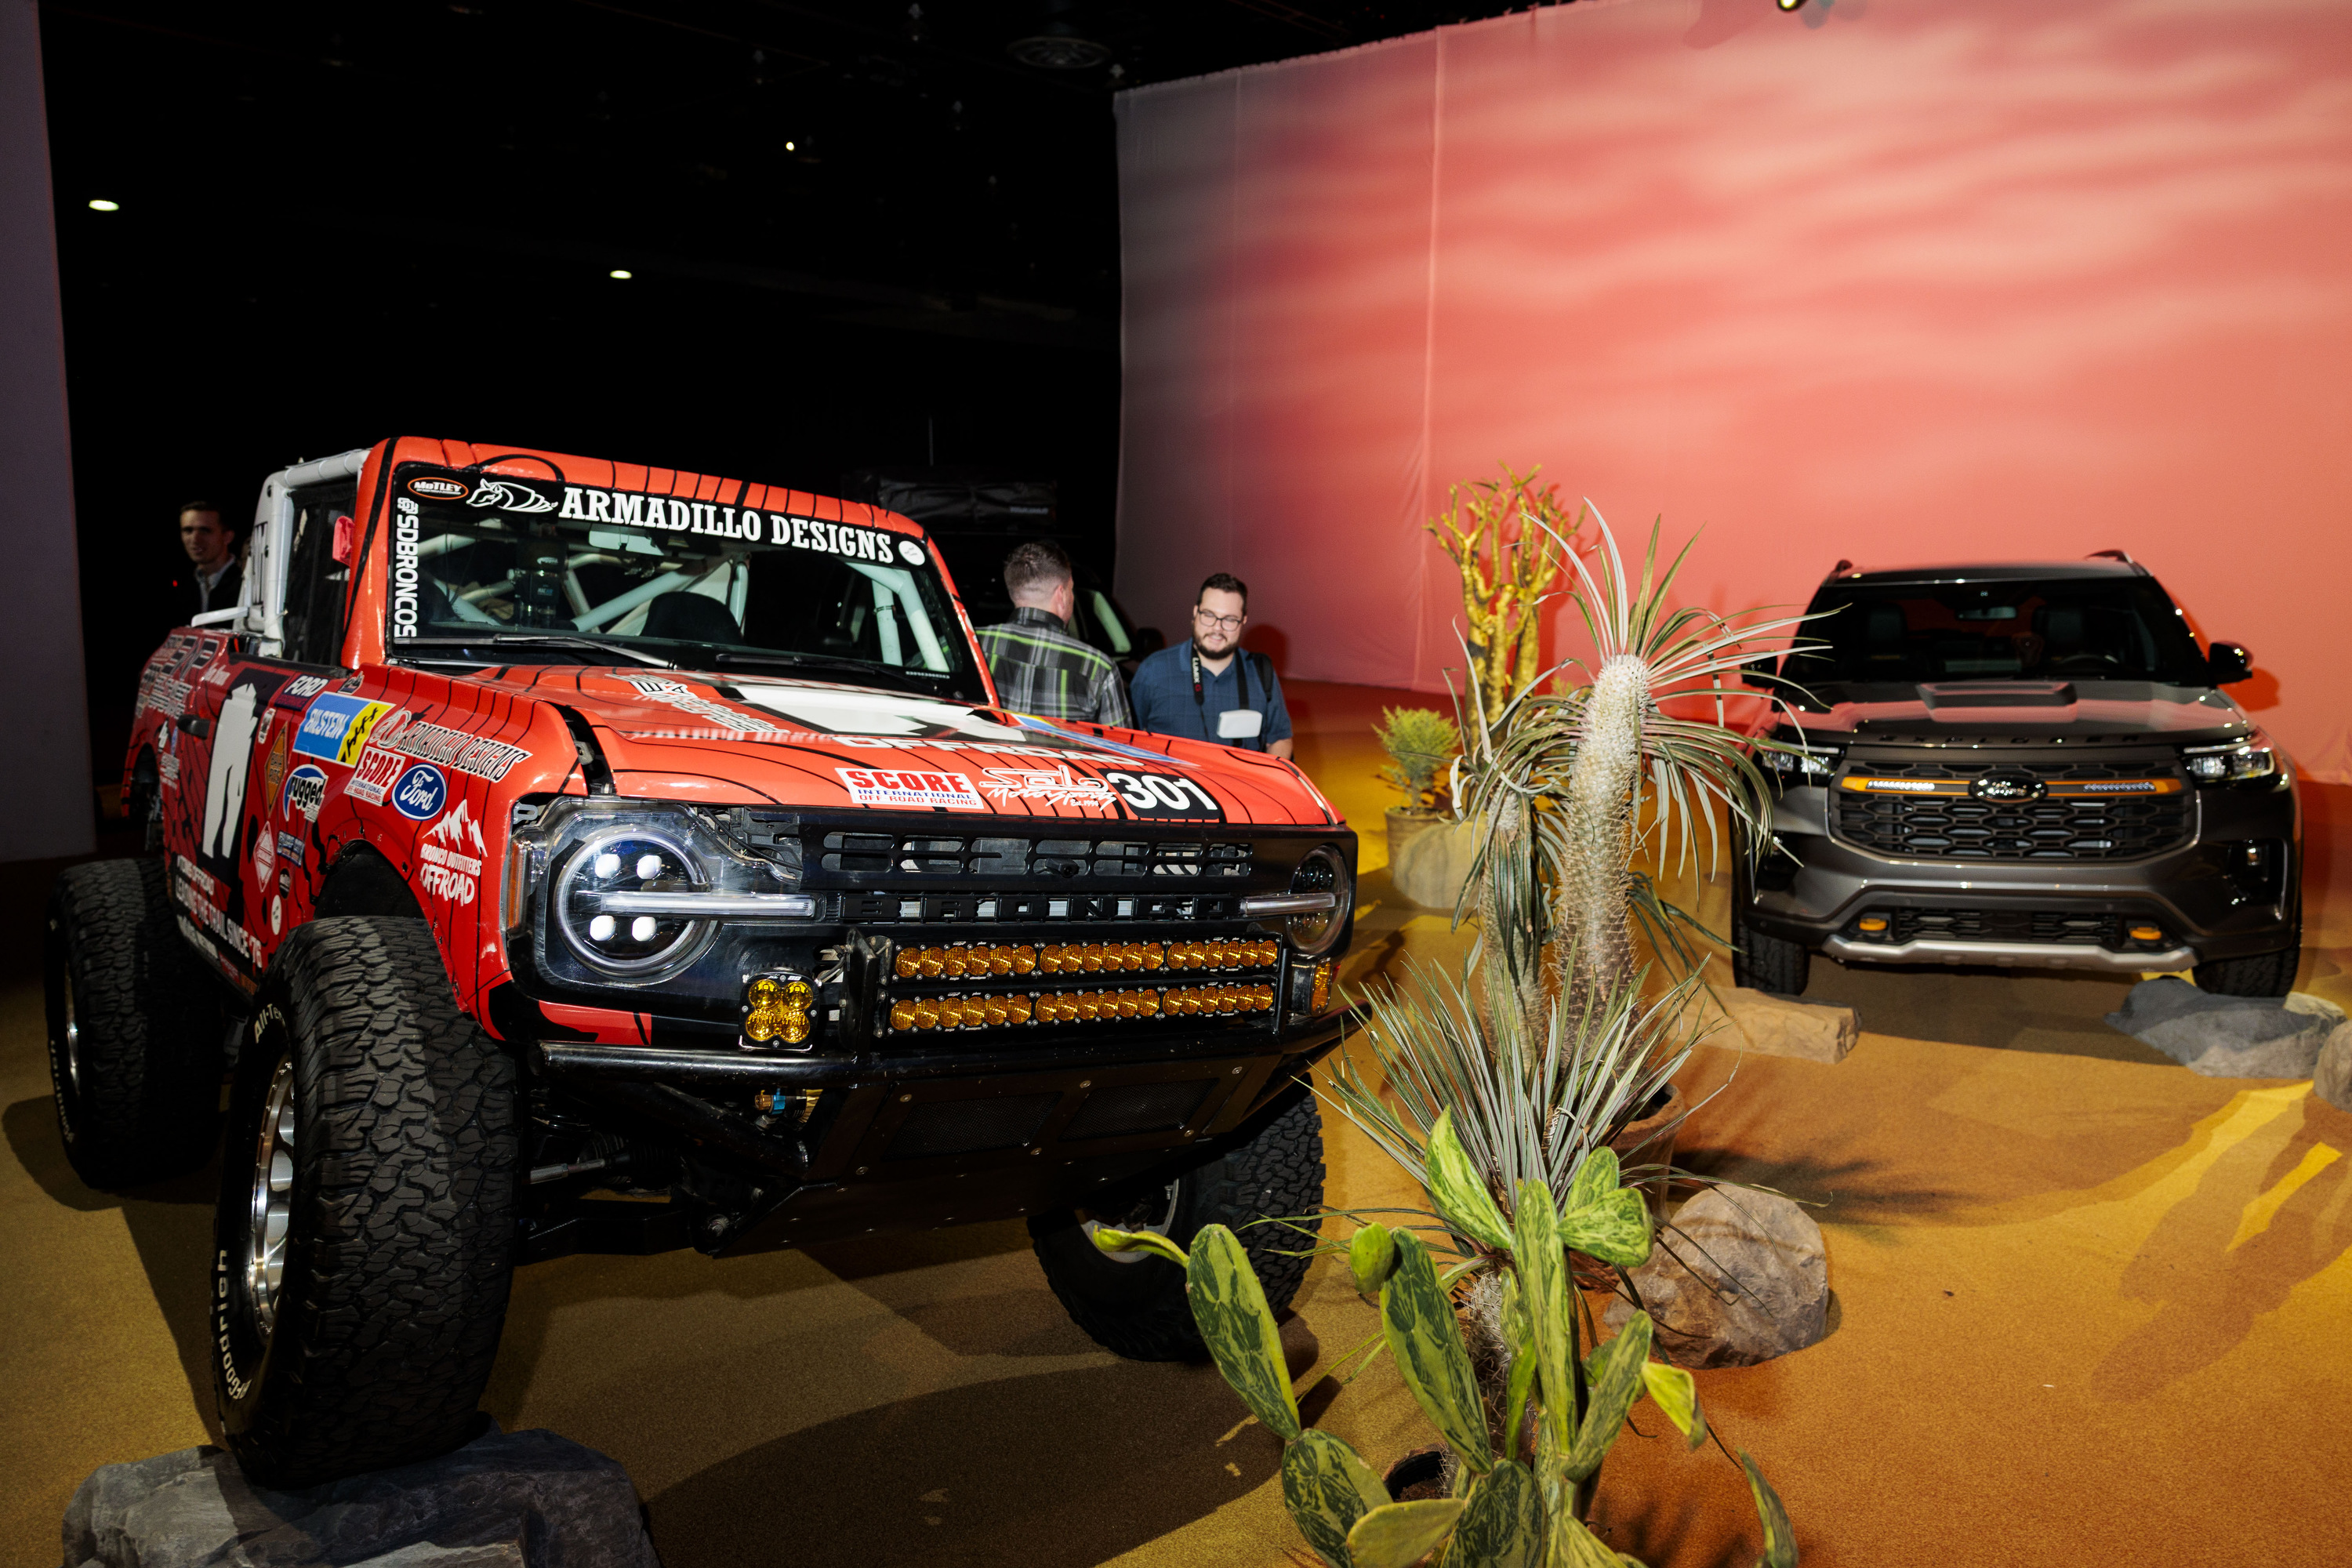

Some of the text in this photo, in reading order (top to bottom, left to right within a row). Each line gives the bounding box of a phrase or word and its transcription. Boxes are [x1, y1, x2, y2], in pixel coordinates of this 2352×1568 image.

[558, 486, 894, 564] ARMADILLO DESIGNS
[394, 514, 419, 637] SDBRONCOS
[284, 675, 329, 698] FORD
[303, 708, 350, 740] BILSTEIN
[394, 720, 534, 783] ARMADILLO DESIGNS
[832, 736, 1145, 767] OFFROAD
[355, 750, 402, 788] SCORE
[846, 771, 971, 793] SCORE
[288, 774, 327, 809] rugged
[400, 769, 439, 811] Ford
[858, 789, 975, 800] INTERNATIONAL
[930, 797, 977, 806] RACING
[986, 787, 1116, 812] Motorsports
[1106, 771, 1218, 811] 301
[420, 843, 482, 877] BRONCO OUTFITTERS
[419, 862, 475, 907] OFFROAD
